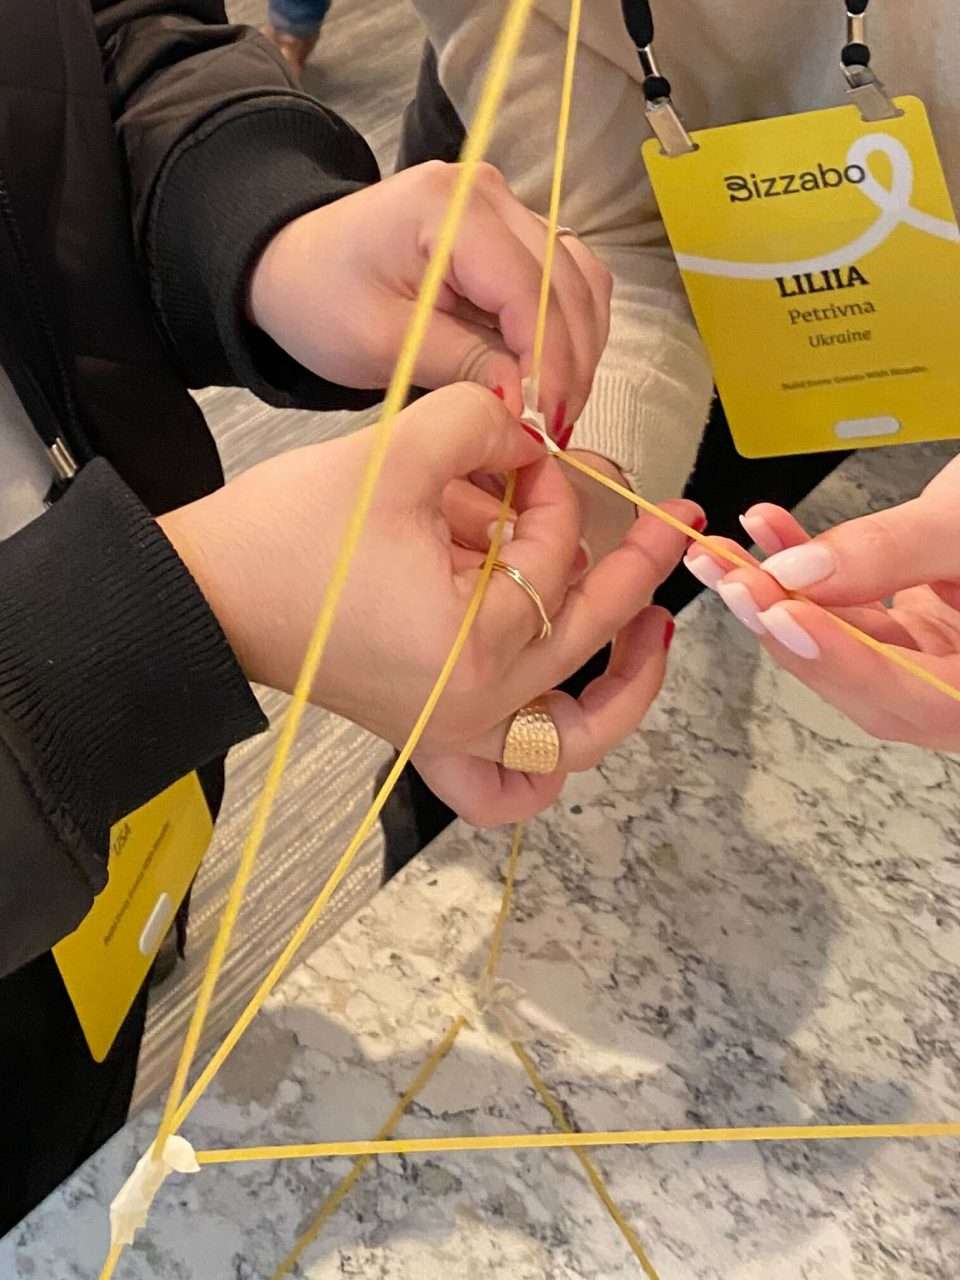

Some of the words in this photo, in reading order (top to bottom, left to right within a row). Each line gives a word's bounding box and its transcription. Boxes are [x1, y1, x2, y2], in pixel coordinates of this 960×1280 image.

[724, 163, 865, 202] Bizzabo
[775, 266, 869, 297] LILIIA
[788, 301, 876, 325] Petrivna
[808, 330, 871, 348] Ukraine
